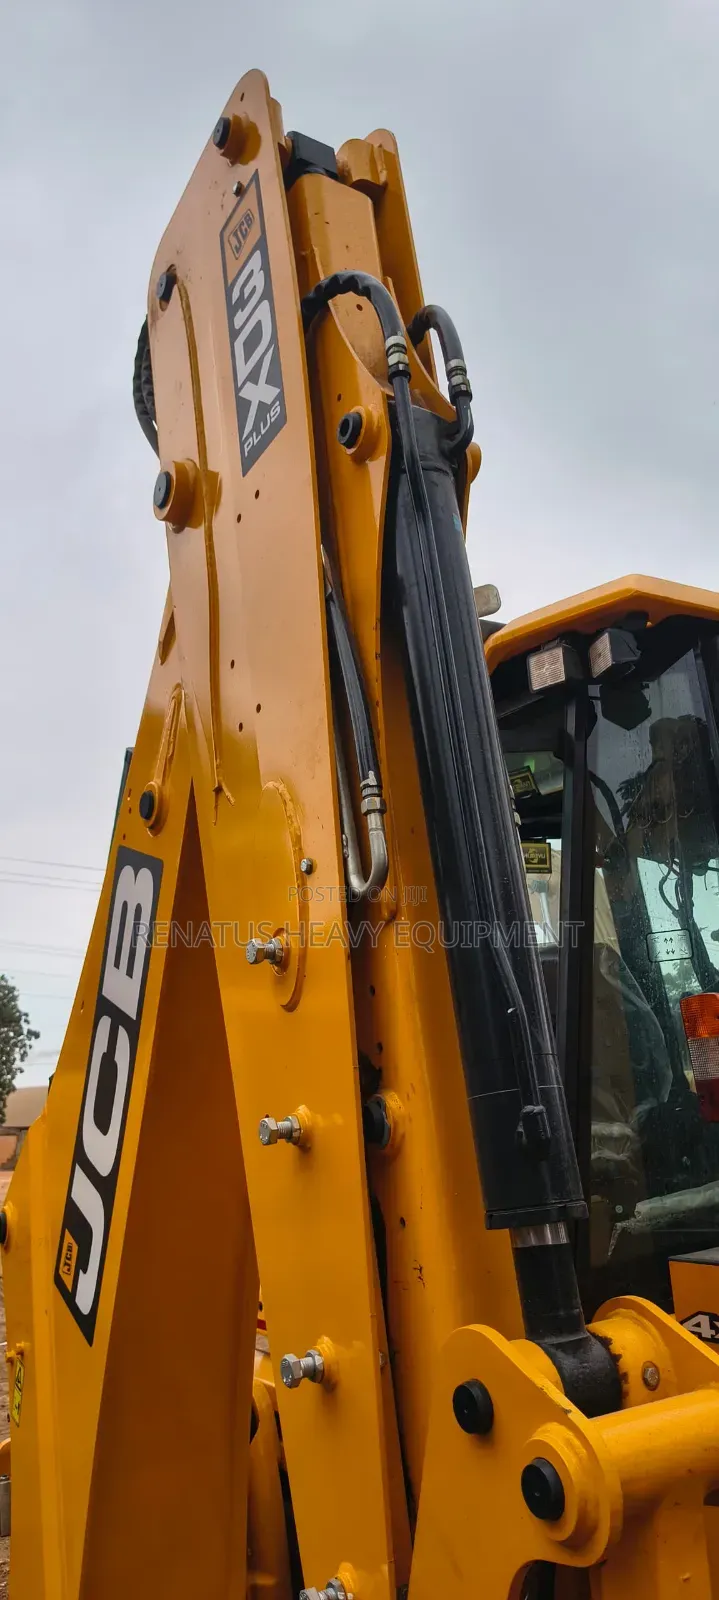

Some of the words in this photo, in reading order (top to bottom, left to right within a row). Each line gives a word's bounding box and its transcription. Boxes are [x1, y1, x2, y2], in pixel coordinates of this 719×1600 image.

[231, 211, 254, 255] JCB
[231, 249, 281, 441] 3DX
[243, 400, 282, 458] PLUS
[70, 864, 154, 1316] JCB
[63, 1242, 74, 1274] JCB
